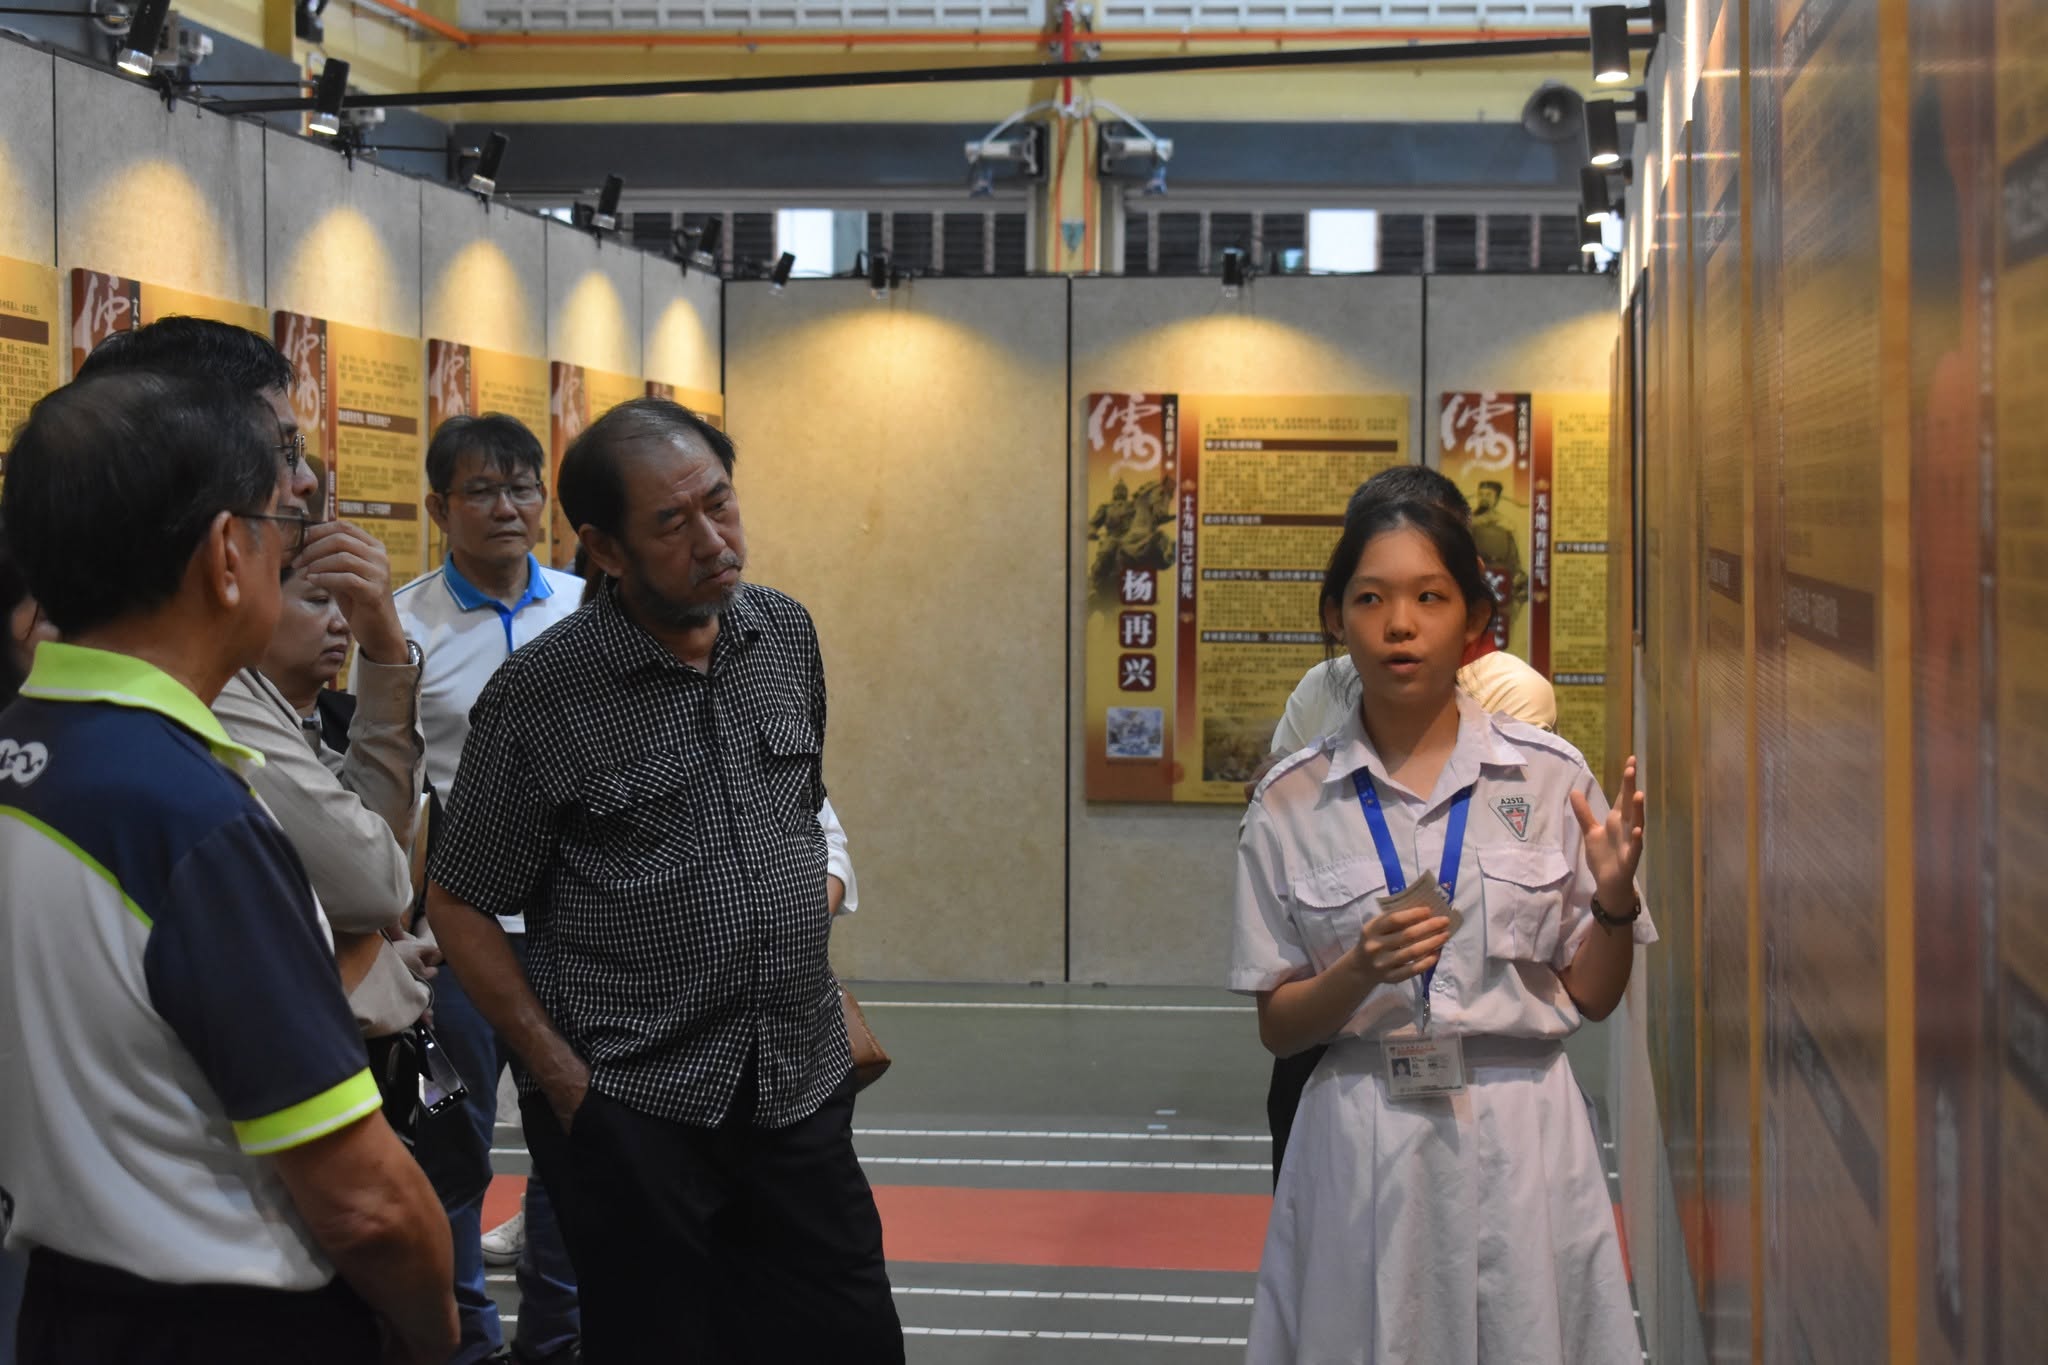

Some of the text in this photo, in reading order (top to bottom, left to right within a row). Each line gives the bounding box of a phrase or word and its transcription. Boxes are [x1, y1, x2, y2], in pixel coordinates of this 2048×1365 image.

[1088, 393, 1162, 474] 儒
[1441, 392, 1515, 478] 儒
[1535, 495, 1549, 586] 天地有正气
[1120, 568, 1155, 688] 杨再兴
[1500, 796, 1525, 805] A2512
